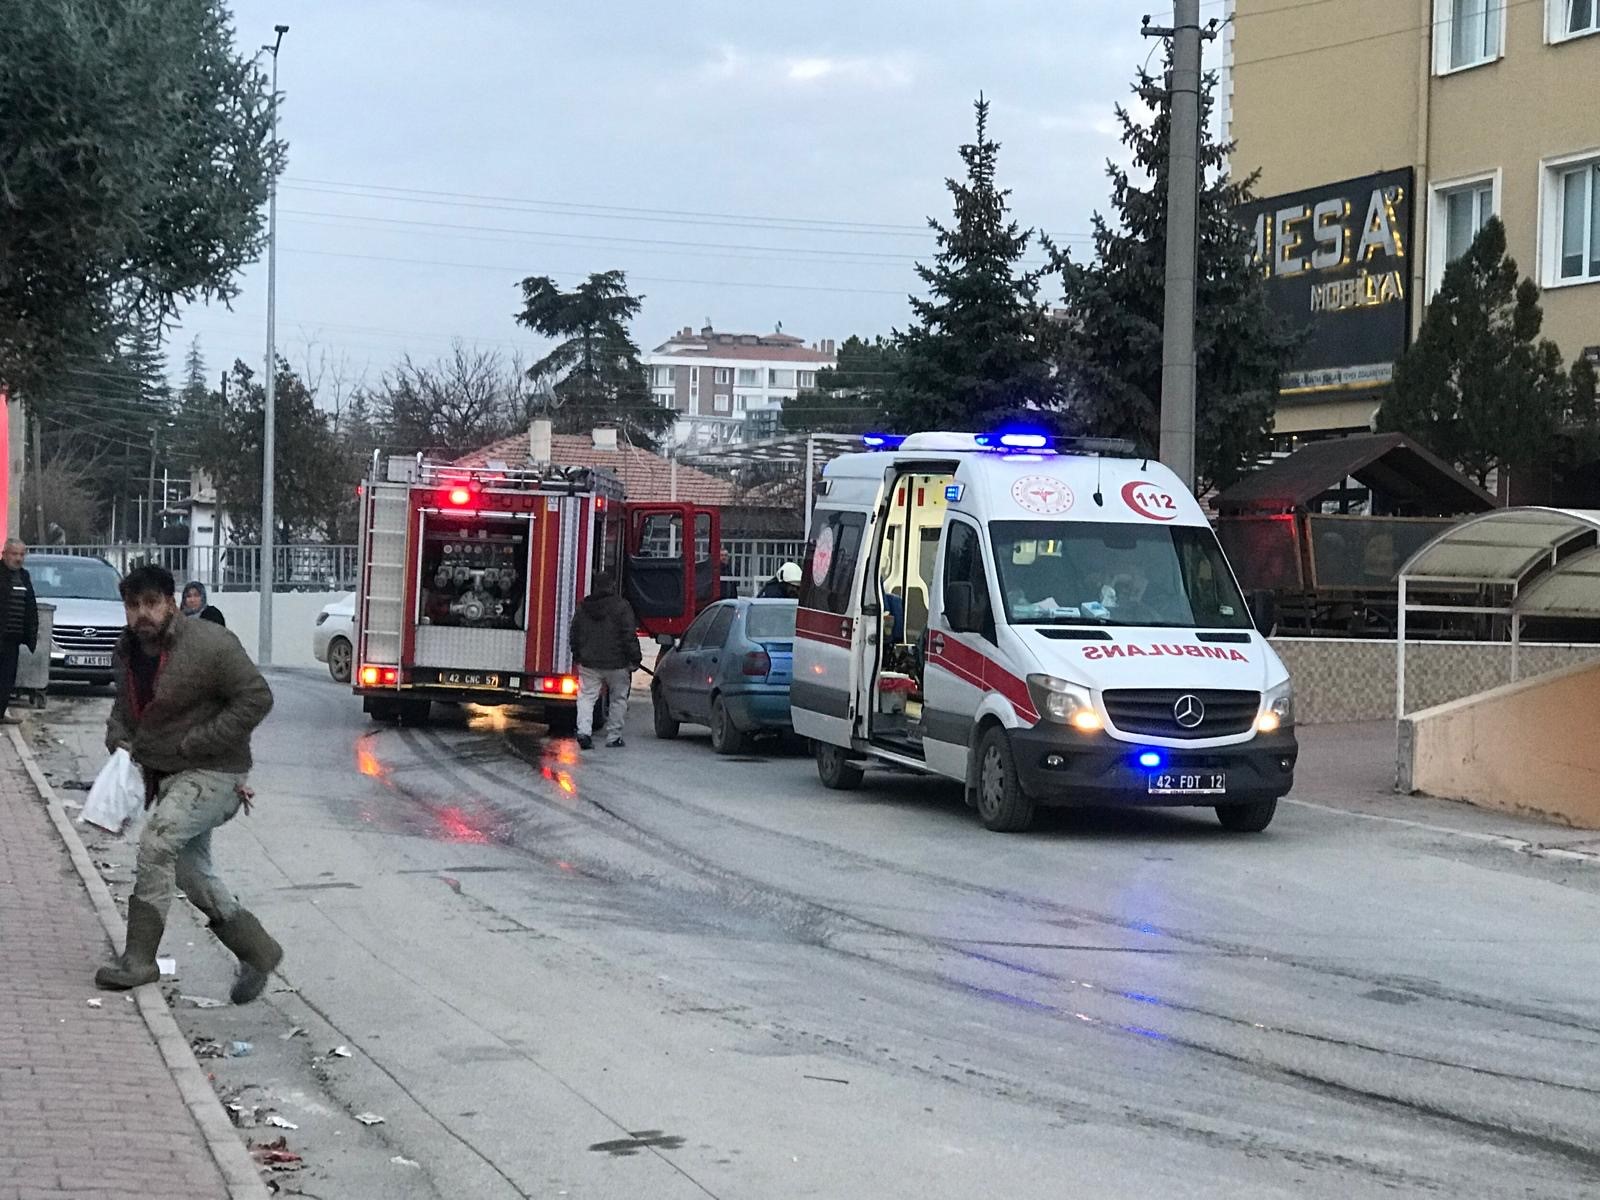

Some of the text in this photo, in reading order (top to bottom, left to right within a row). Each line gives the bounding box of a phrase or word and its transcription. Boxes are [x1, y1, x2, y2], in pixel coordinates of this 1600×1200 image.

[1136, 492, 1177, 509] 112
[449, 673, 460, 683] 42
[1156, 775, 1223, 788] 42 FDT 12
